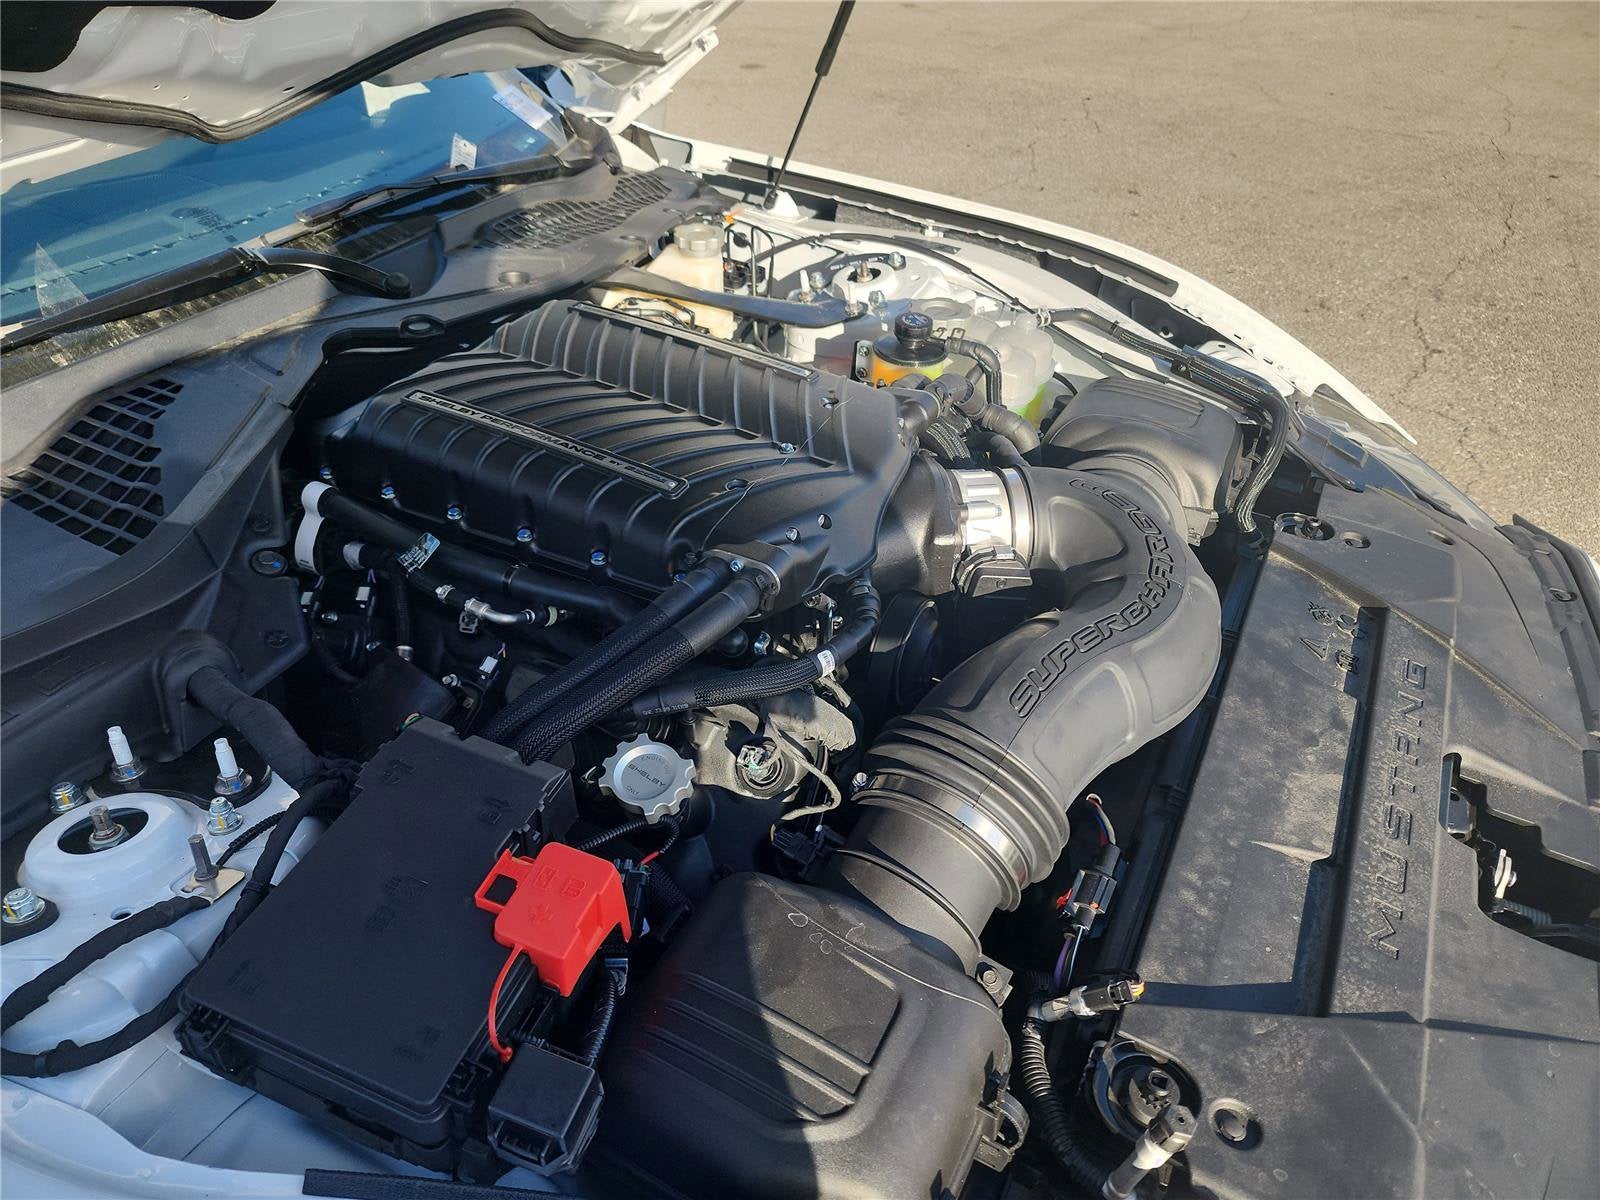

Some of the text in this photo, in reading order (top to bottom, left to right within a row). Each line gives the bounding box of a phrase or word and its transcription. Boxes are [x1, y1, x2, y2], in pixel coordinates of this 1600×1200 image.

[418, 395, 482, 419] SHELBY
[481, 414, 609, 461] PERFORMANCE
[1008, 478, 1175, 718] SUPERCHARGED
[627, 763, 666, 787] SHELBY
[1367, 657, 1427, 960] MUSTANG
